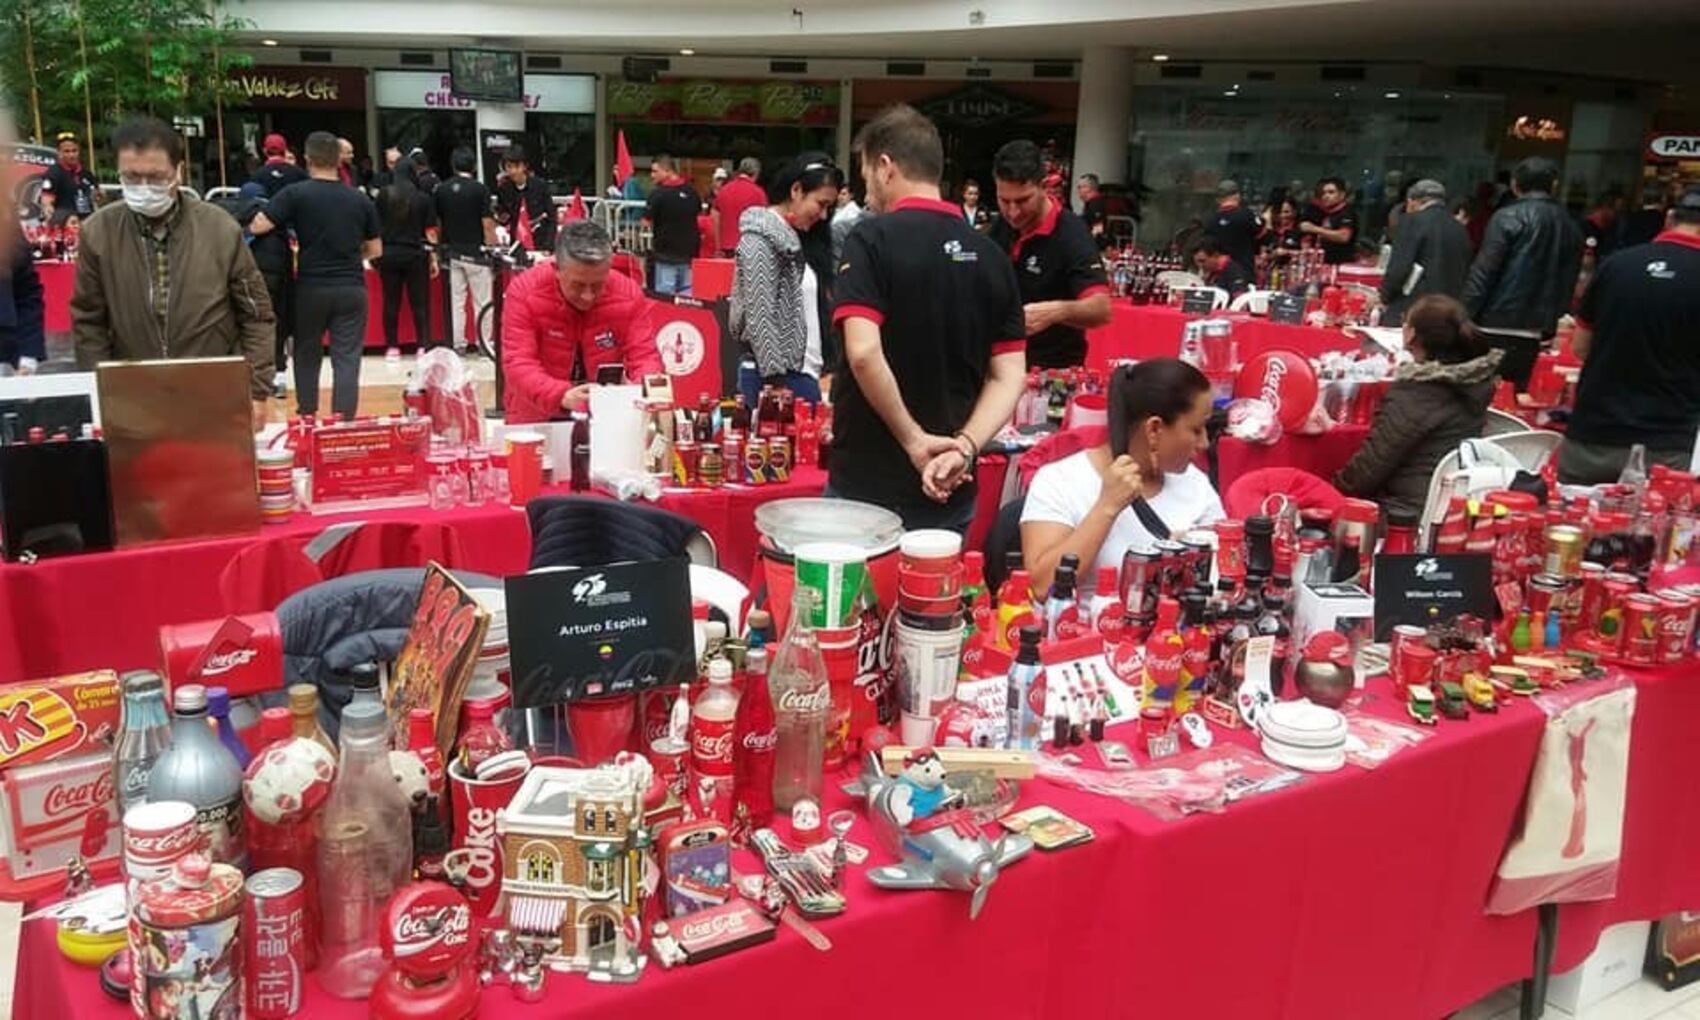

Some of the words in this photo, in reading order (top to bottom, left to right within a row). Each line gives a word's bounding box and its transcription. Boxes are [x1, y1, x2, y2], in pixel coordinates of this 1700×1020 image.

[559, 623, 602, 637] Arturo
[604, 616, 648, 632] Espitia
[464, 807, 496, 888] Coke
